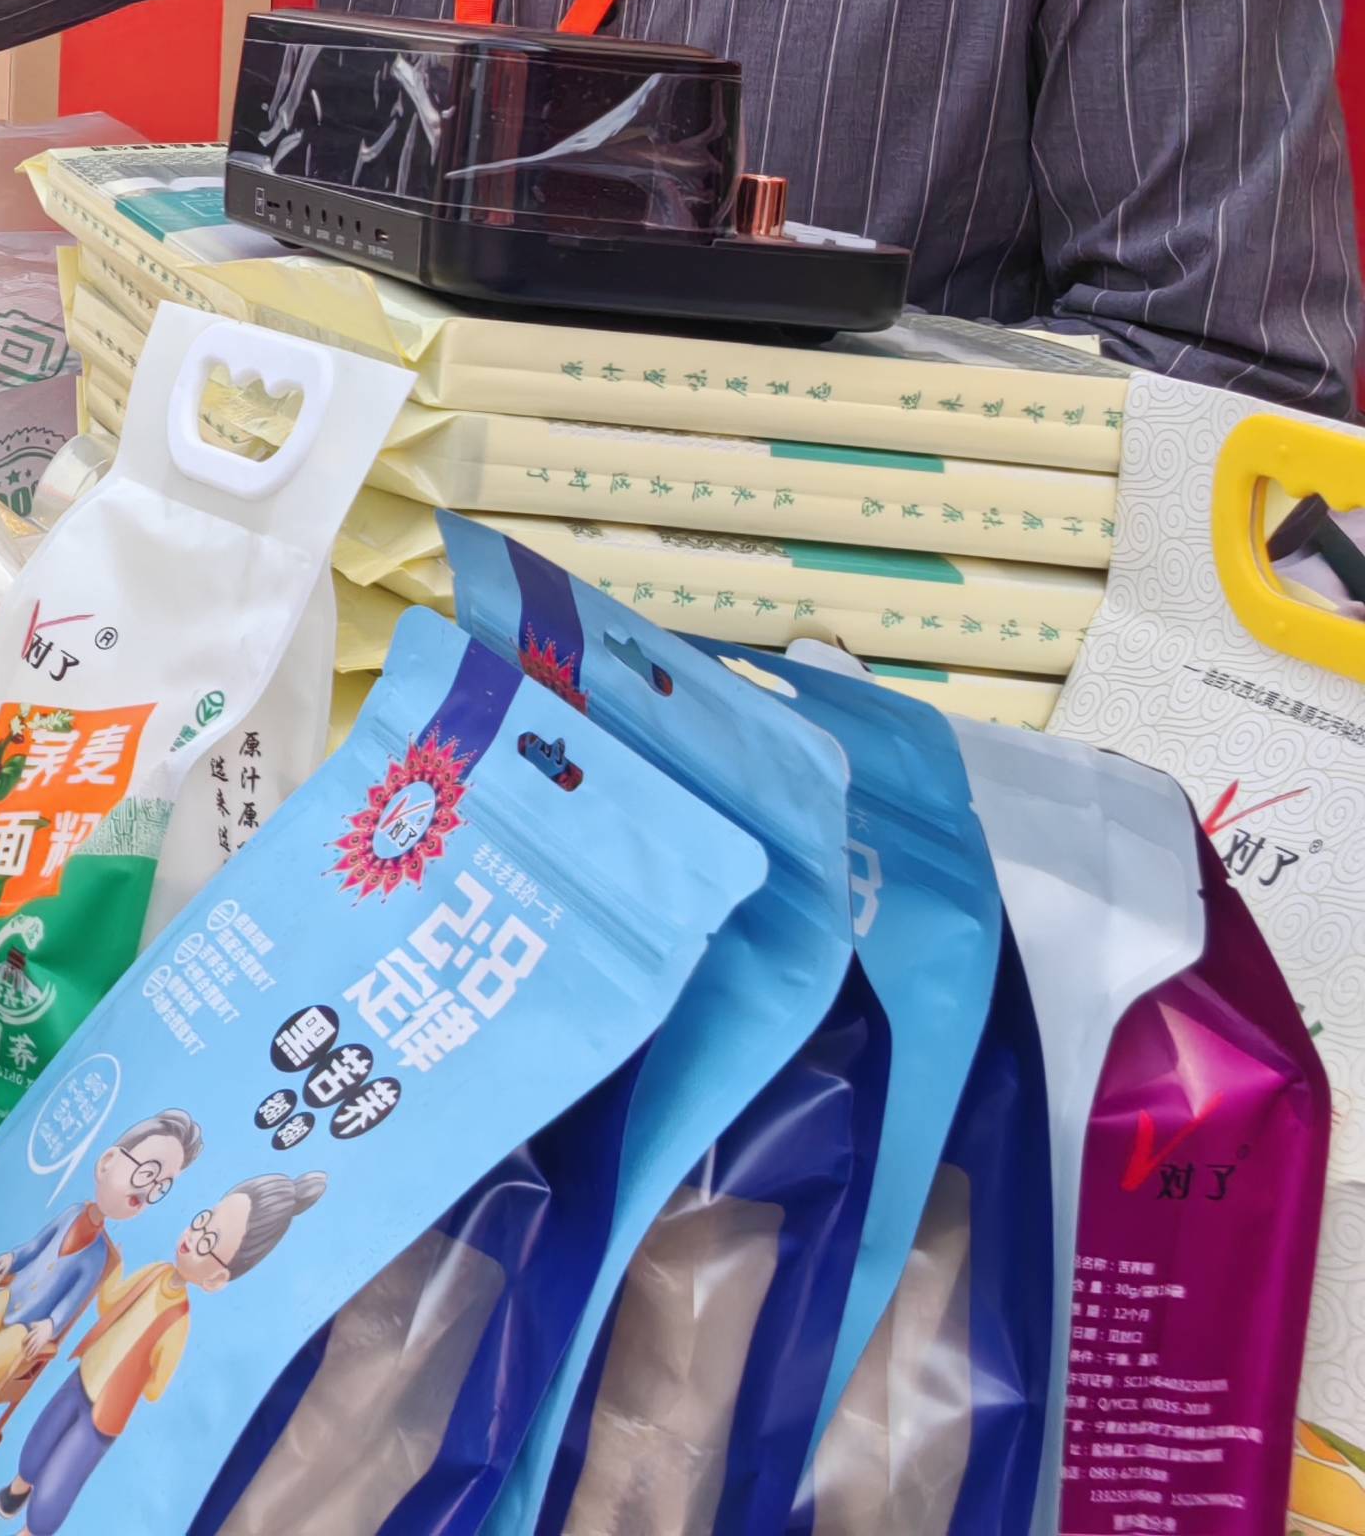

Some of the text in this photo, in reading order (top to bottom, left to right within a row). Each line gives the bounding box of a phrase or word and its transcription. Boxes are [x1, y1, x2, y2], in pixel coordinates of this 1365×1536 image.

[24, 632, 80, 682] 对了
[1221, 828, 1299, 886] 对了
[474, 843, 565, 931] 老夫老妻的一天
[274, 1009, 395, 1136] 黑苦荞
[1156, 1162, 1235, 1202] 对了
